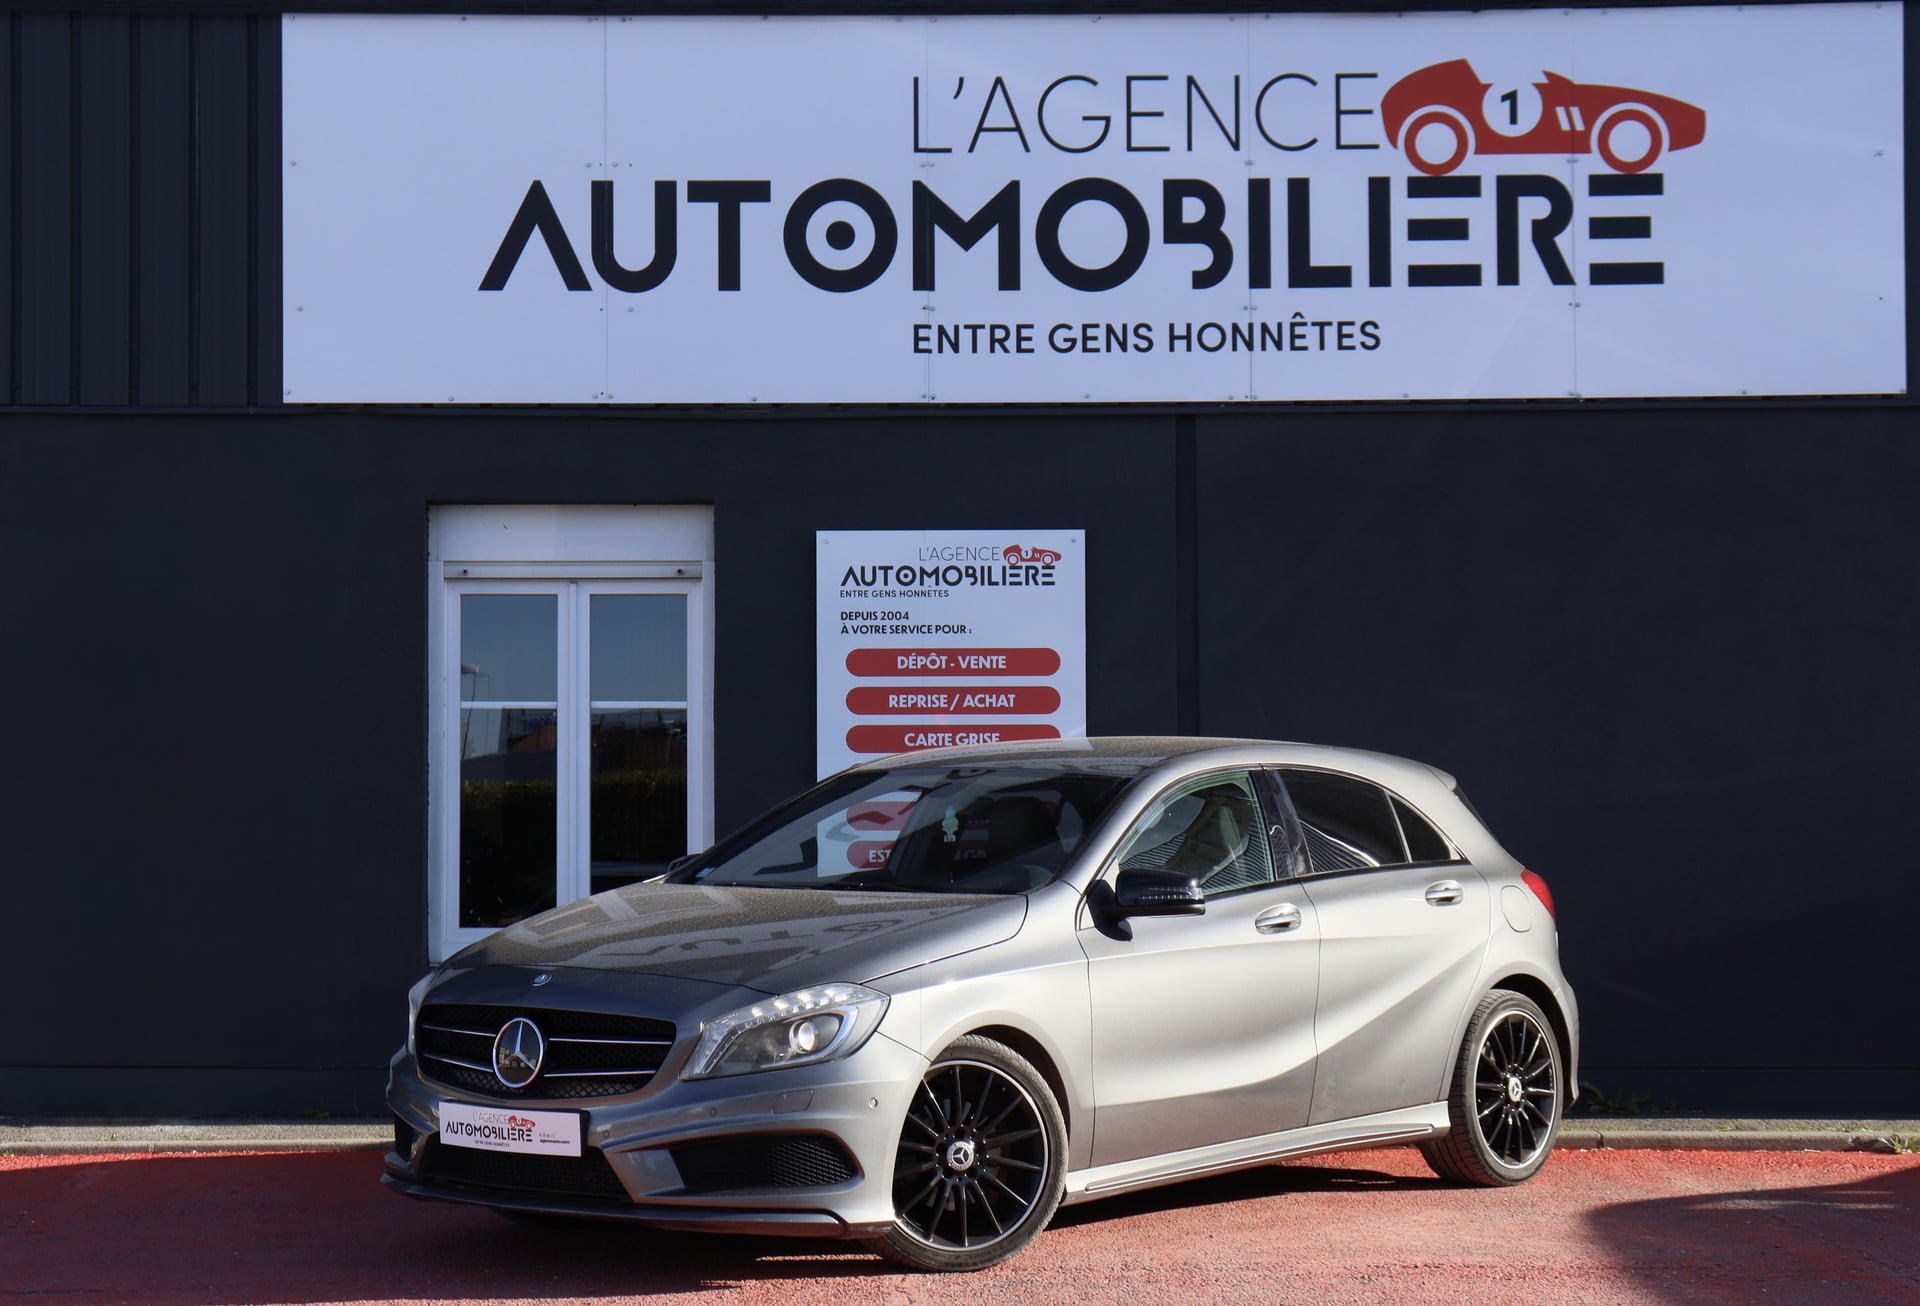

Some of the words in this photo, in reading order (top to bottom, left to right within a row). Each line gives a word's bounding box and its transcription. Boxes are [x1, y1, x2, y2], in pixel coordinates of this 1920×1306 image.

[1499, 88, 1519, 126] 1
[912, 323, 1035, 354] ENTRE
[1048, 322, 1154, 354] GENS
[1168, 312, 1381, 353] HONNÊTES
[840, 589, 869, 598] ENTRE
[871, 589, 897, 598] GENS
[899, 585, 950, 598] HONNÊTES
[840, 611, 878, 621] DEPUIS
[880, 611, 910, 621] 2004
[840, 623, 850, 635] À
[851, 624, 888, 635] VOTRE
[889, 624, 934, 635] SERVICE
[935, 624, 967, 635] POUR
[897, 652, 948, 670] DÉPÔT
[957, 655, 1007, 669] VENTE
[888, 694, 949, 708] REPRISE
[963, 693, 1016, 708] ACHAT
[904, 732, 953, 747] CARTE
[955, 732, 1000, 746] GRISE
